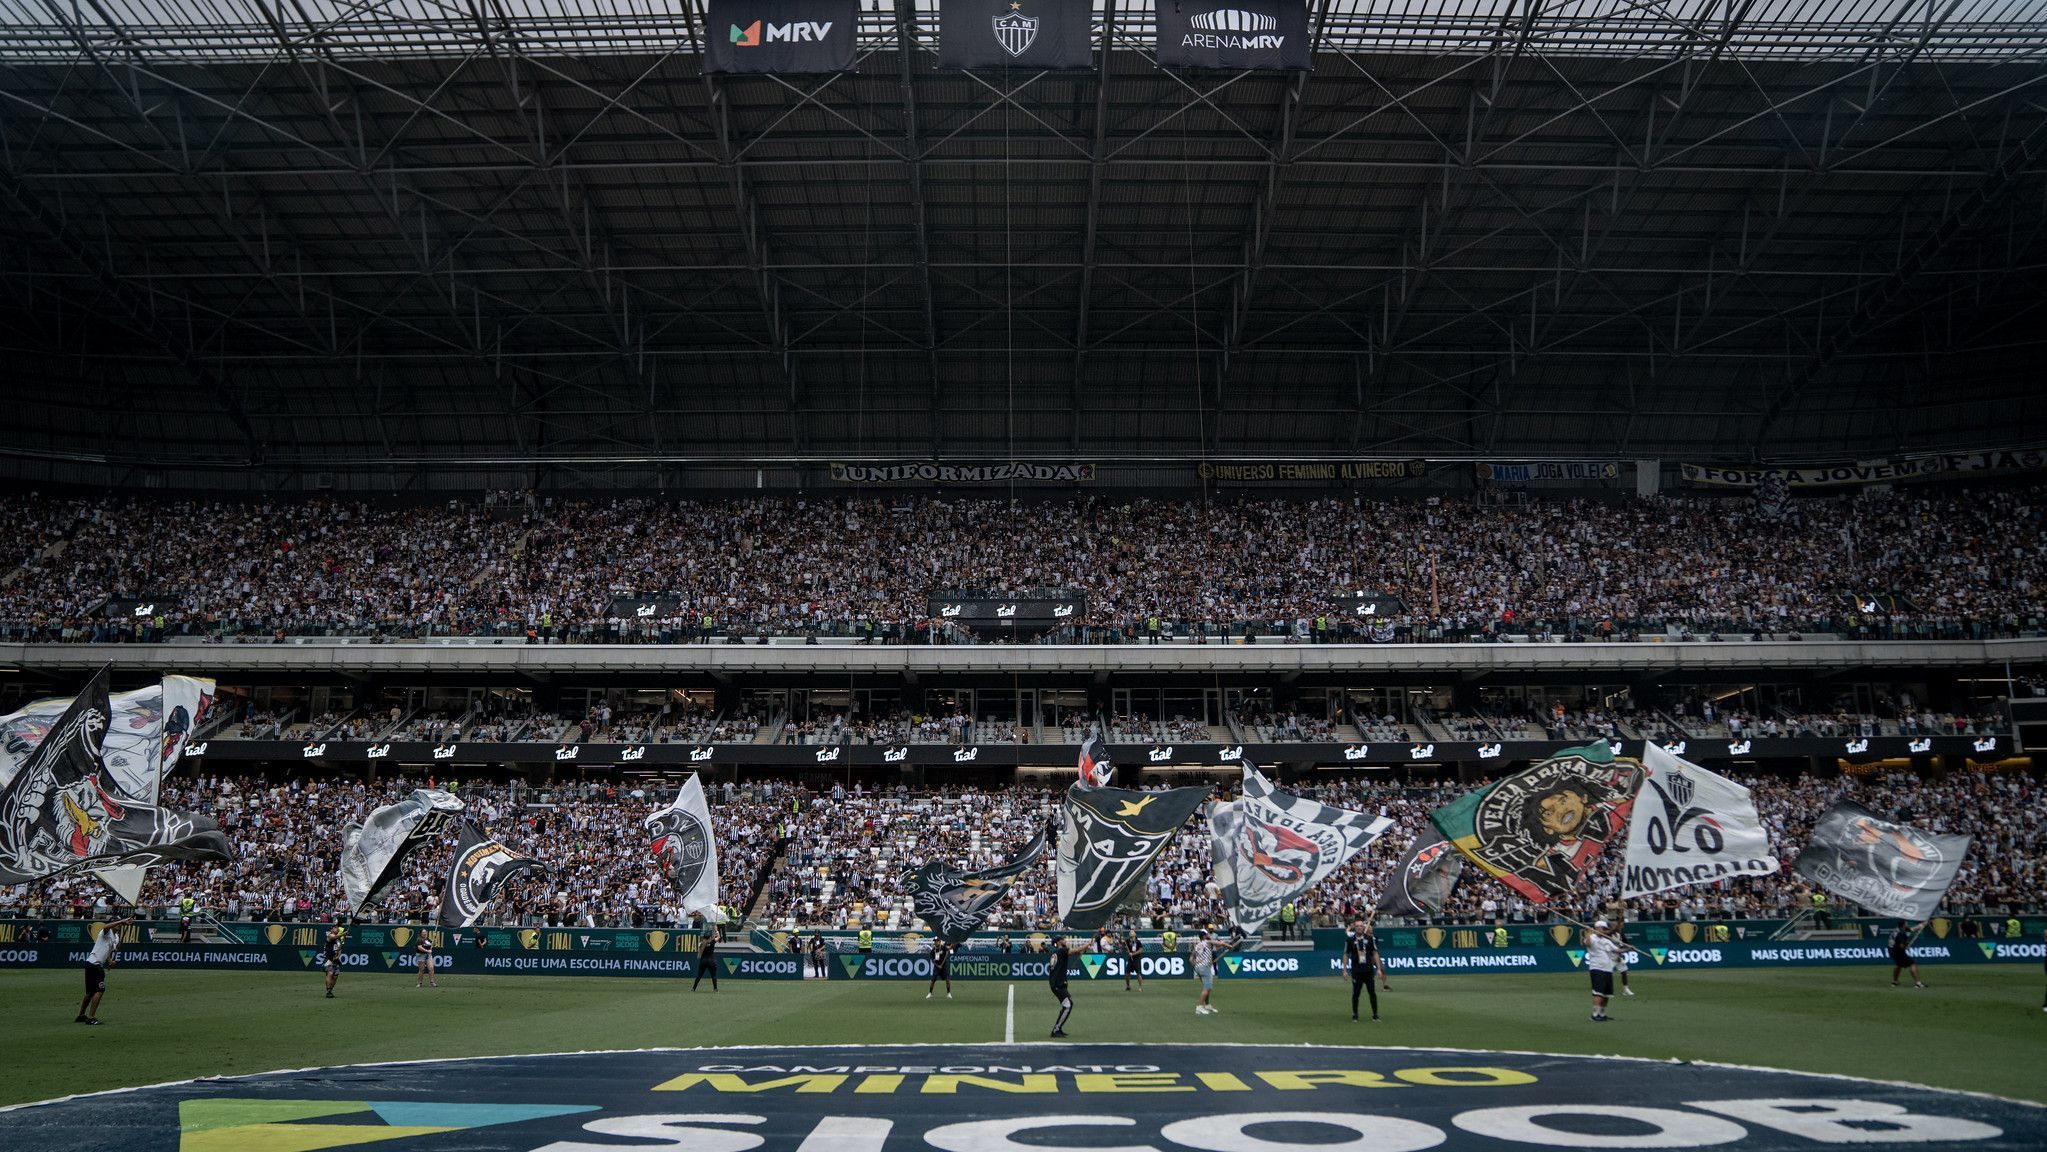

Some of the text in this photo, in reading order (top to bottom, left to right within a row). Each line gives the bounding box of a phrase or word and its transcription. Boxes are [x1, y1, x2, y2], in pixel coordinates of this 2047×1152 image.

[766, 21, 833, 43] MRV
[999, 20, 1032, 28] CAM
[1181, 33, 1285, 50] ARENAMRV
[846, 463, 1077, 482] UNIFORMIZADA
[1215, 462, 1405, 480] UNIVERSO FEMININO ALVINEGRO
[1493, 463, 1530, 480] MARIA
[1533, 463, 1564, 479] JOGA
[1813, 460, 1918, 483] JOVEM
[0, 924, 16, 943] NAL
[120, 924, 141, 944] INAL
[292, 927, 318, 946] FINAL
[547, 932, 574, 950] FINAL
[1452, 930, 1479, 949] FINAL
[0, 950, 38, 962] COOB
[69, 951, 92, 962] MAI
[124, 951, 149, 962] UMA
[152, 951, 200, 962] ESCOLHA
[204, 952, 268, 963] FINANCEIRA
[316, 953, 369, 966] SOOB
[399, 955, 453, 967] SIOB
[1387, 957, 1416, 969] UMA
[1416, 956, 1469, 968] ESCOLHA
[1470, 954, 1538, 967] FINANCEIRA
[1667, 949, 1723, 963] SICOOB
[1751, 946, 1951, 961] MAIS QUE UMA ESCOLHA NCEIRA
[484, 957, 691, 971] MAIS QUE UMA ESCOLHA FINANCEIRA
[741, 959, 797, 974] SICOOB
[949, 962, 1010, 977] MINEIRO
[1011, 962, 1051, 977] SICOO
[1106, 957, 1185, 976] SIOOB
[1242, 957, 1299, 972] SICOOB
[697, 1064, 1162, 1074] CAMPEONATO
[650, 1066, 1540, 1094] MINEIRO
[522, 1099, 2005, 1152] SICOOB
